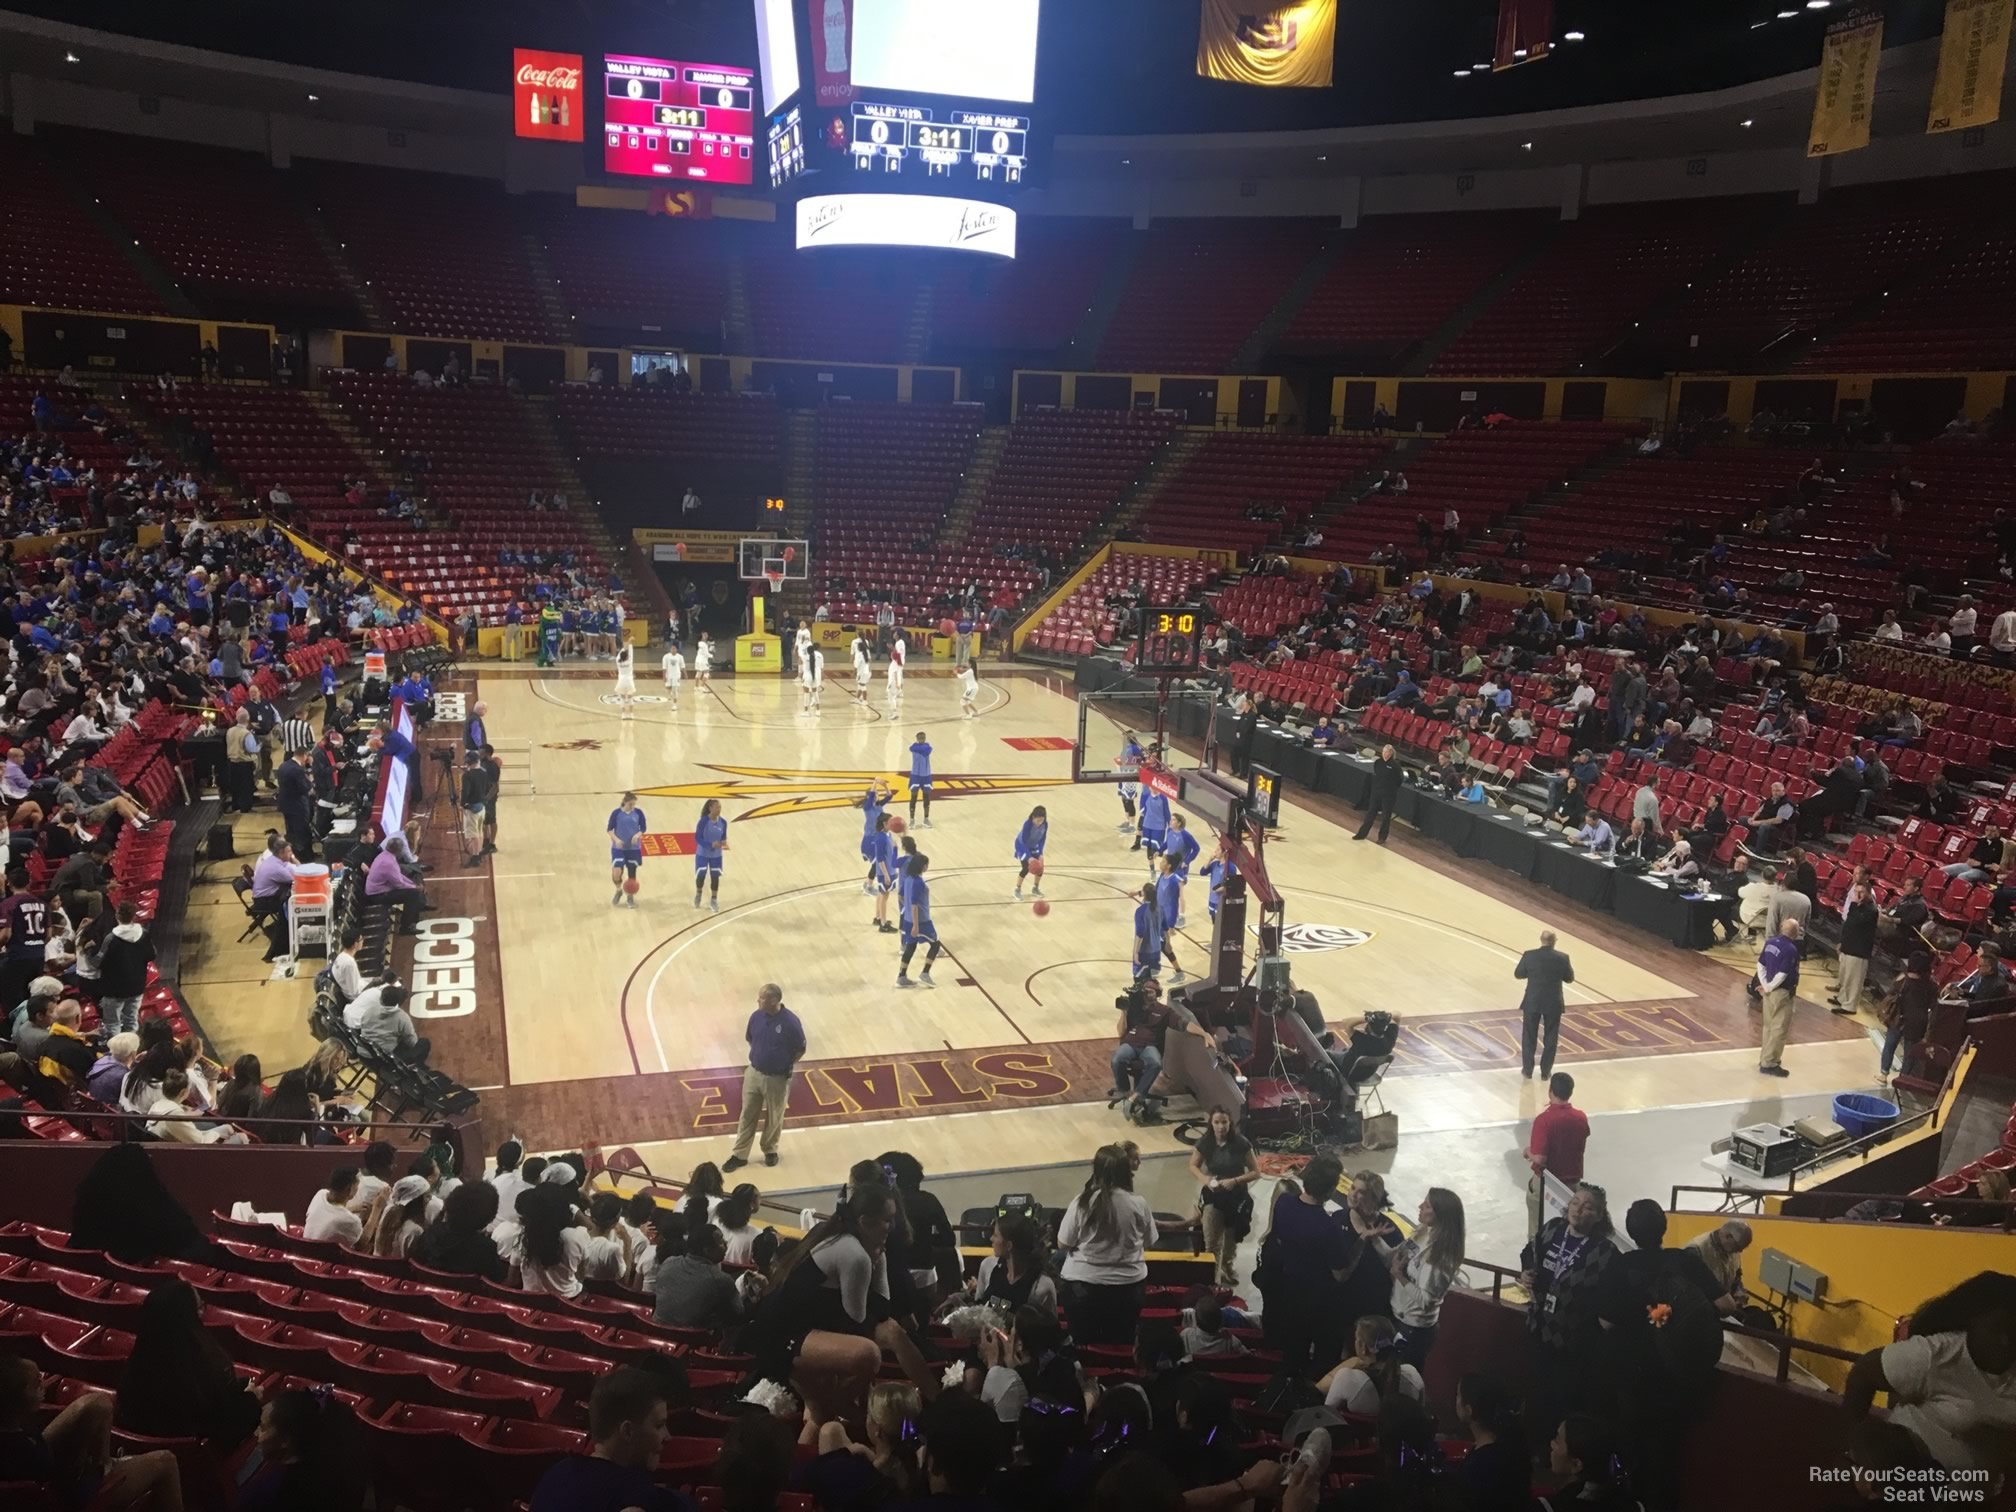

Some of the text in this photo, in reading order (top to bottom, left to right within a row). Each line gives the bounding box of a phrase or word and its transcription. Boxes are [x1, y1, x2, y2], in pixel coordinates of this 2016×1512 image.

[517, 64, 581, 90] Coca-Cola
[627, 79, 643, 99] 0
[718, 88, 733, 108] 0
[821, 82, 854, 98] enjoy
[661, 107, 699, 127] 3:11
[864, 104, 897, 117] VALLEY
[871, 120, 889, 144] 0
[919, 127, 961, 148] 3:11
[992, 131, 1010, 154] 0
[1159, 615, 1193, 633] 3:10
[409, 917, 476, 1019] GEICO
[679, 1052, 1071, 1129] STATE
